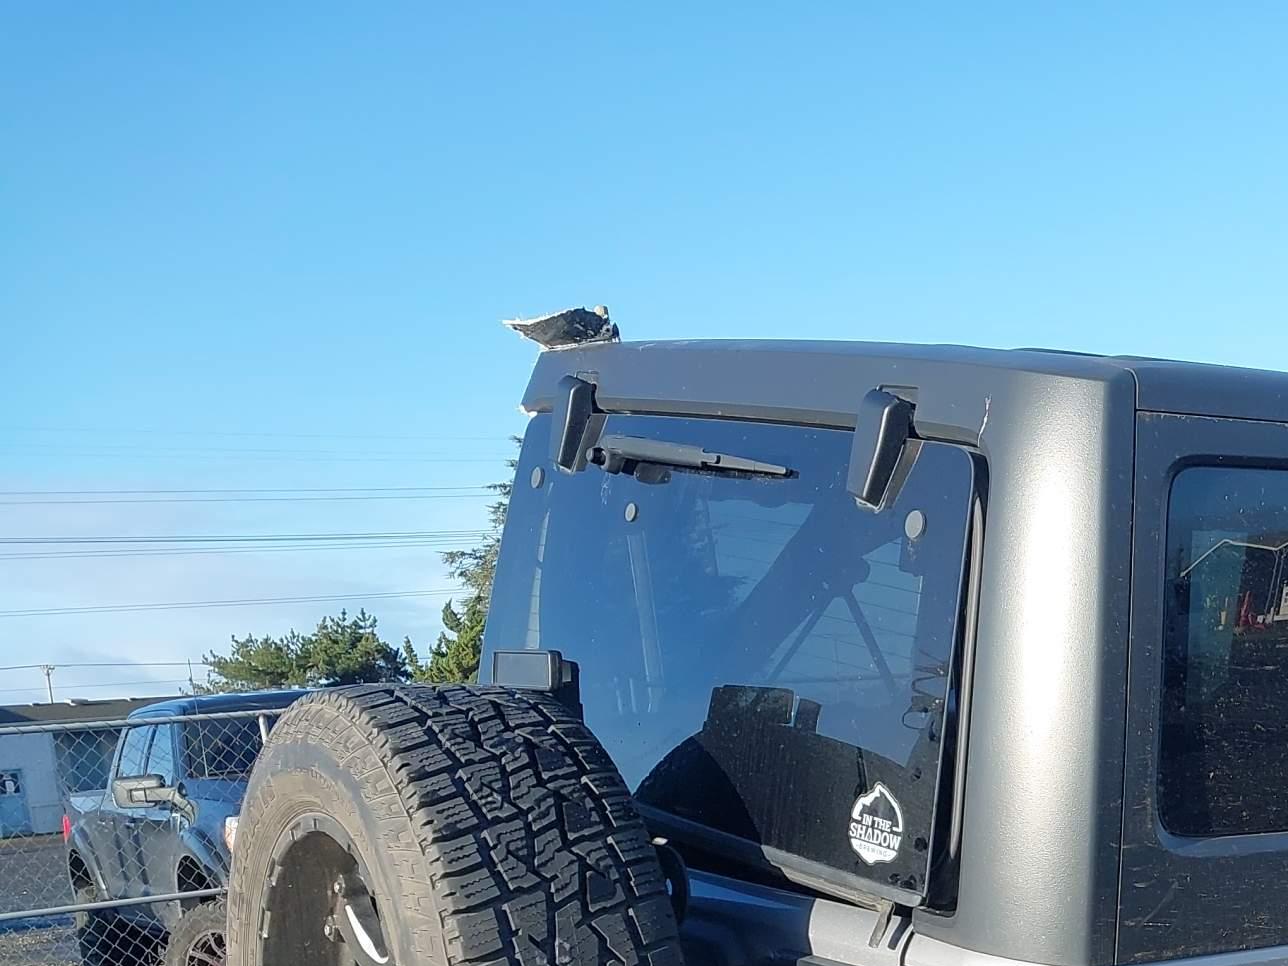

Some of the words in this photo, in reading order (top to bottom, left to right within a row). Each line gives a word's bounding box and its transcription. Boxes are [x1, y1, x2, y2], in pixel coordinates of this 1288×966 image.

[862, 814, 873, 826] IN
[873, 817, 892, 832] THE
[850, 822, 901, 850] SHADOW
